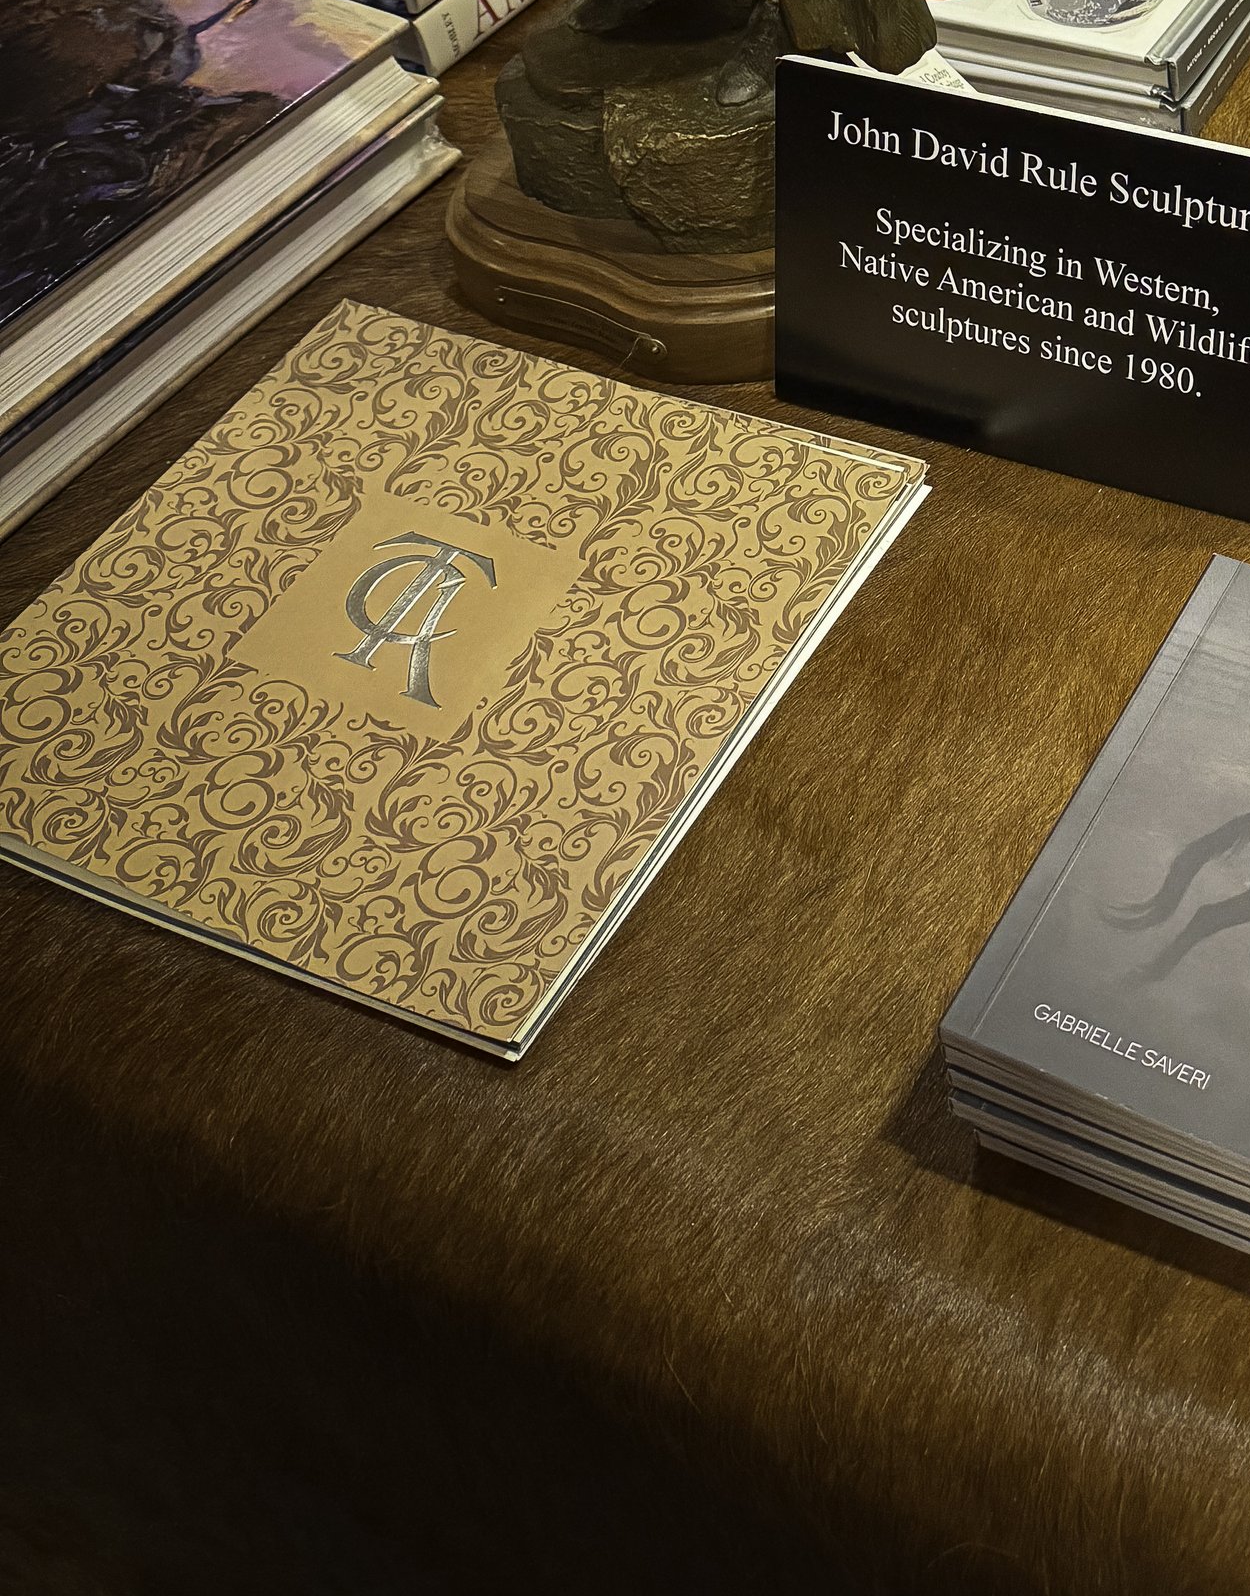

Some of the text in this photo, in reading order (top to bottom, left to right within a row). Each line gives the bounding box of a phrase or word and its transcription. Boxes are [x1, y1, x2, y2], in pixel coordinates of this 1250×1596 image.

[442, 12, 461, 58] MOBLEY
[827, 112, 902, 155] John
[911, 128, 1008, 178] David
[1020, 153, 1098, 197] Rule
[839, 241, 930, 287] Native
[937, 268, 1074, 323] American
[1083, 303, 1135, 337] and
[875, 208, 1221, 316] Specializing in Western,
[892, 304, 1203, 398] sculptures since 1980.
[1034, 1004, 1211, 1089] GABRIELLE SAVERI
